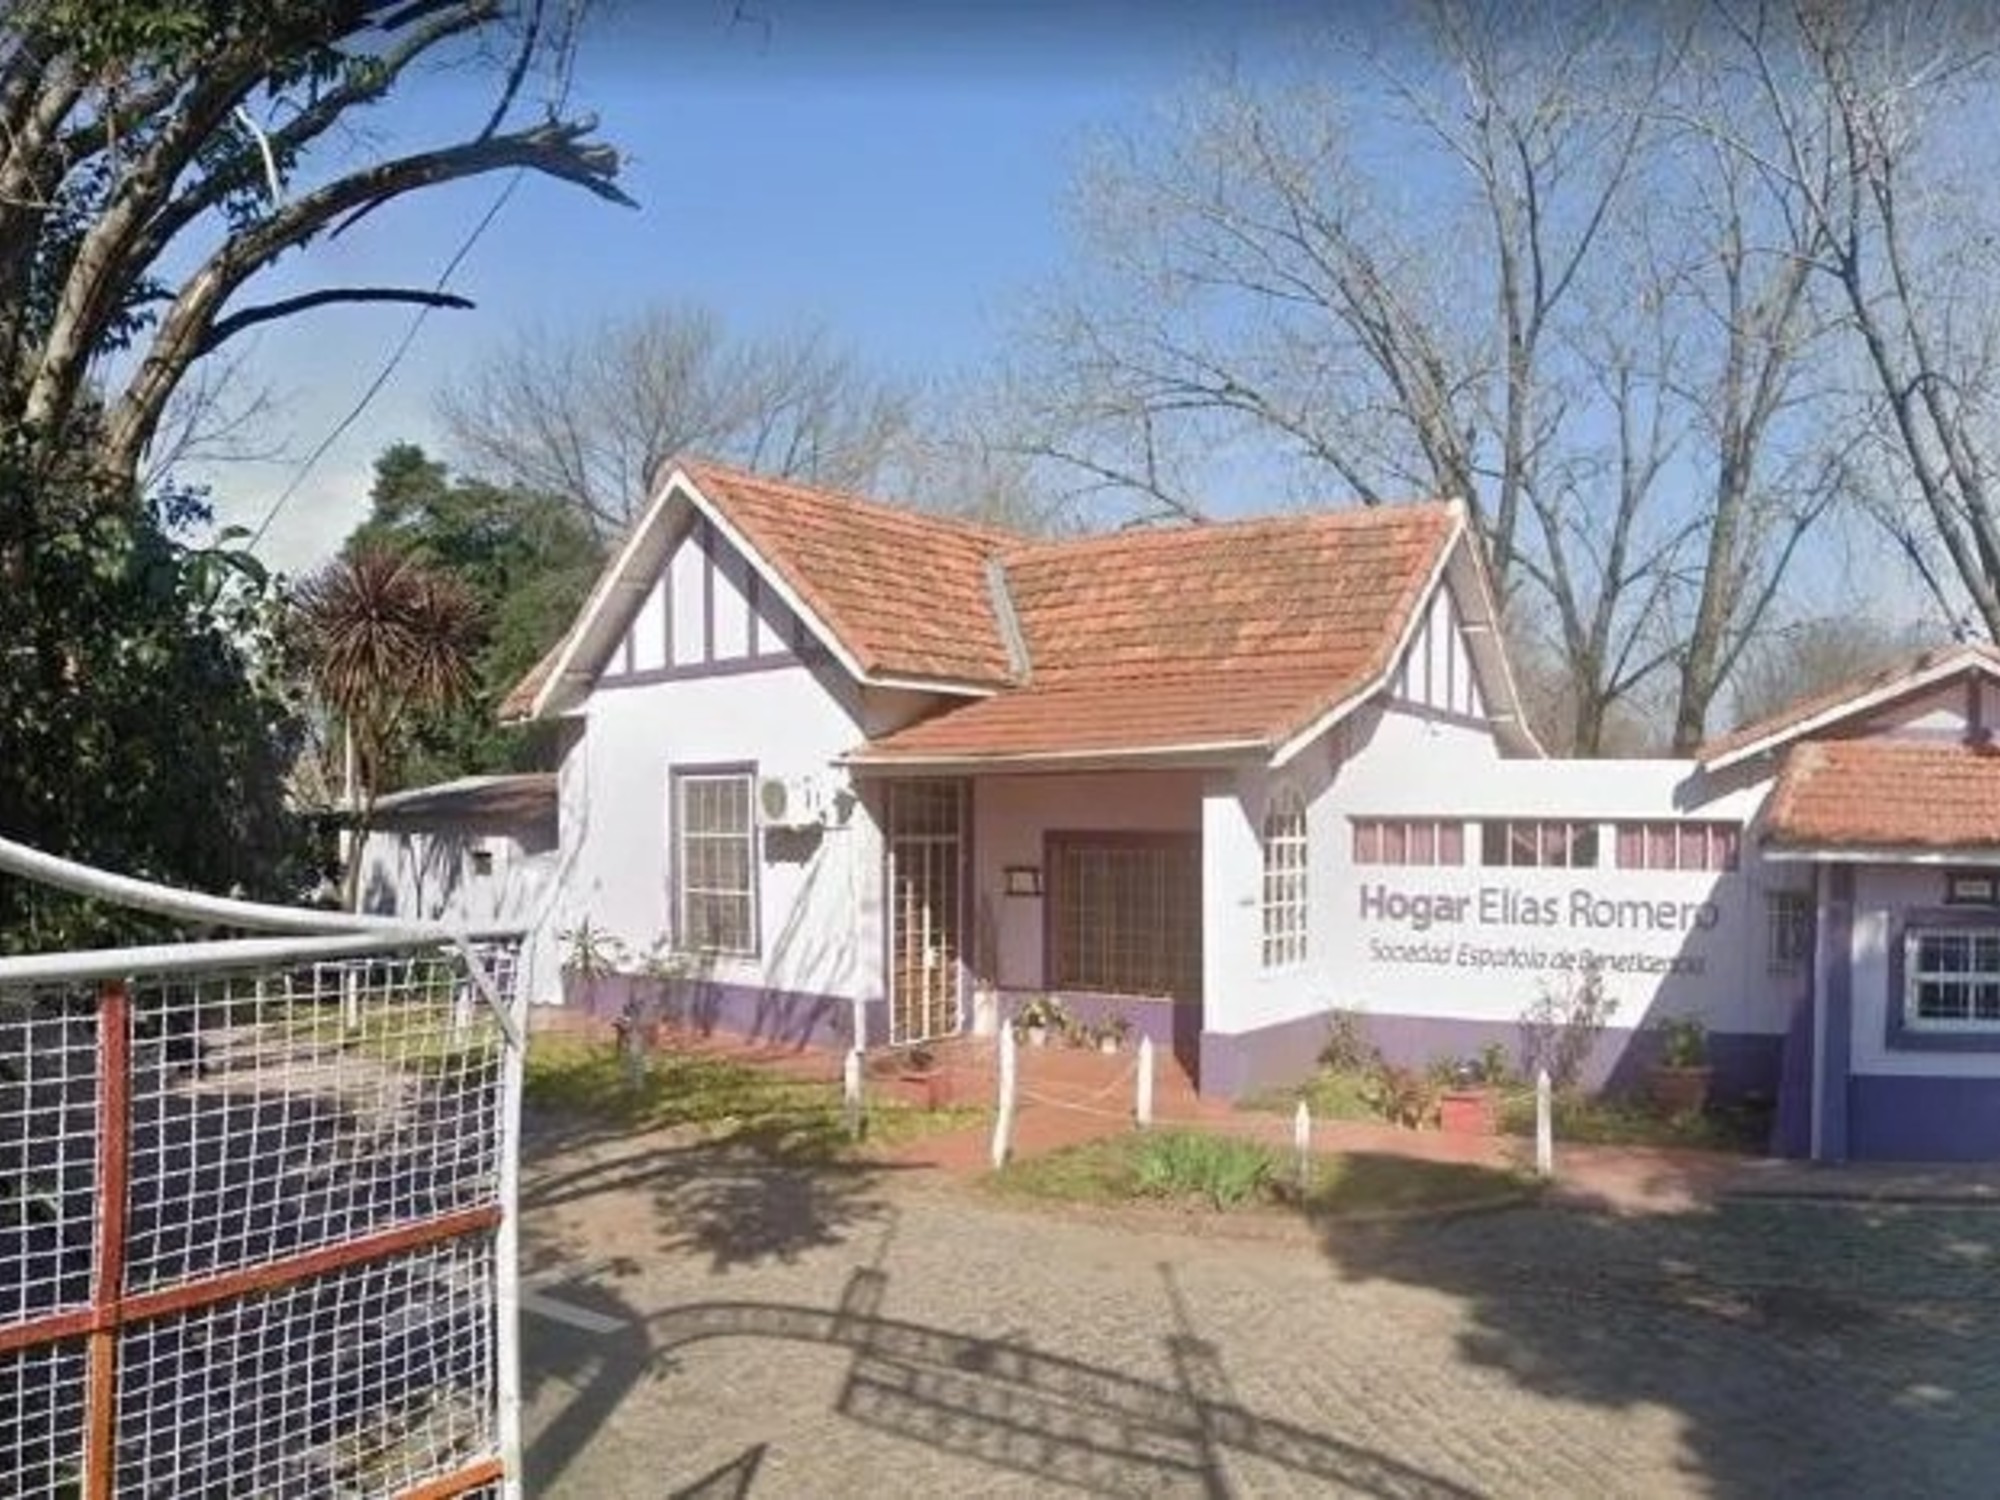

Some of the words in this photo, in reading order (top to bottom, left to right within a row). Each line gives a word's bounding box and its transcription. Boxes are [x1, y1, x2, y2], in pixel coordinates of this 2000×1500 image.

[1360, 884, 1470, 931] Hogar
[1479, 887, 1558, 926] Elías
[1569, 888, 1719, 931] Romero
[1369, 937, 1451, 964] Sociedad
[1456, 942, 1547, 972] Española
[1550, 949, 1577, 971] de
